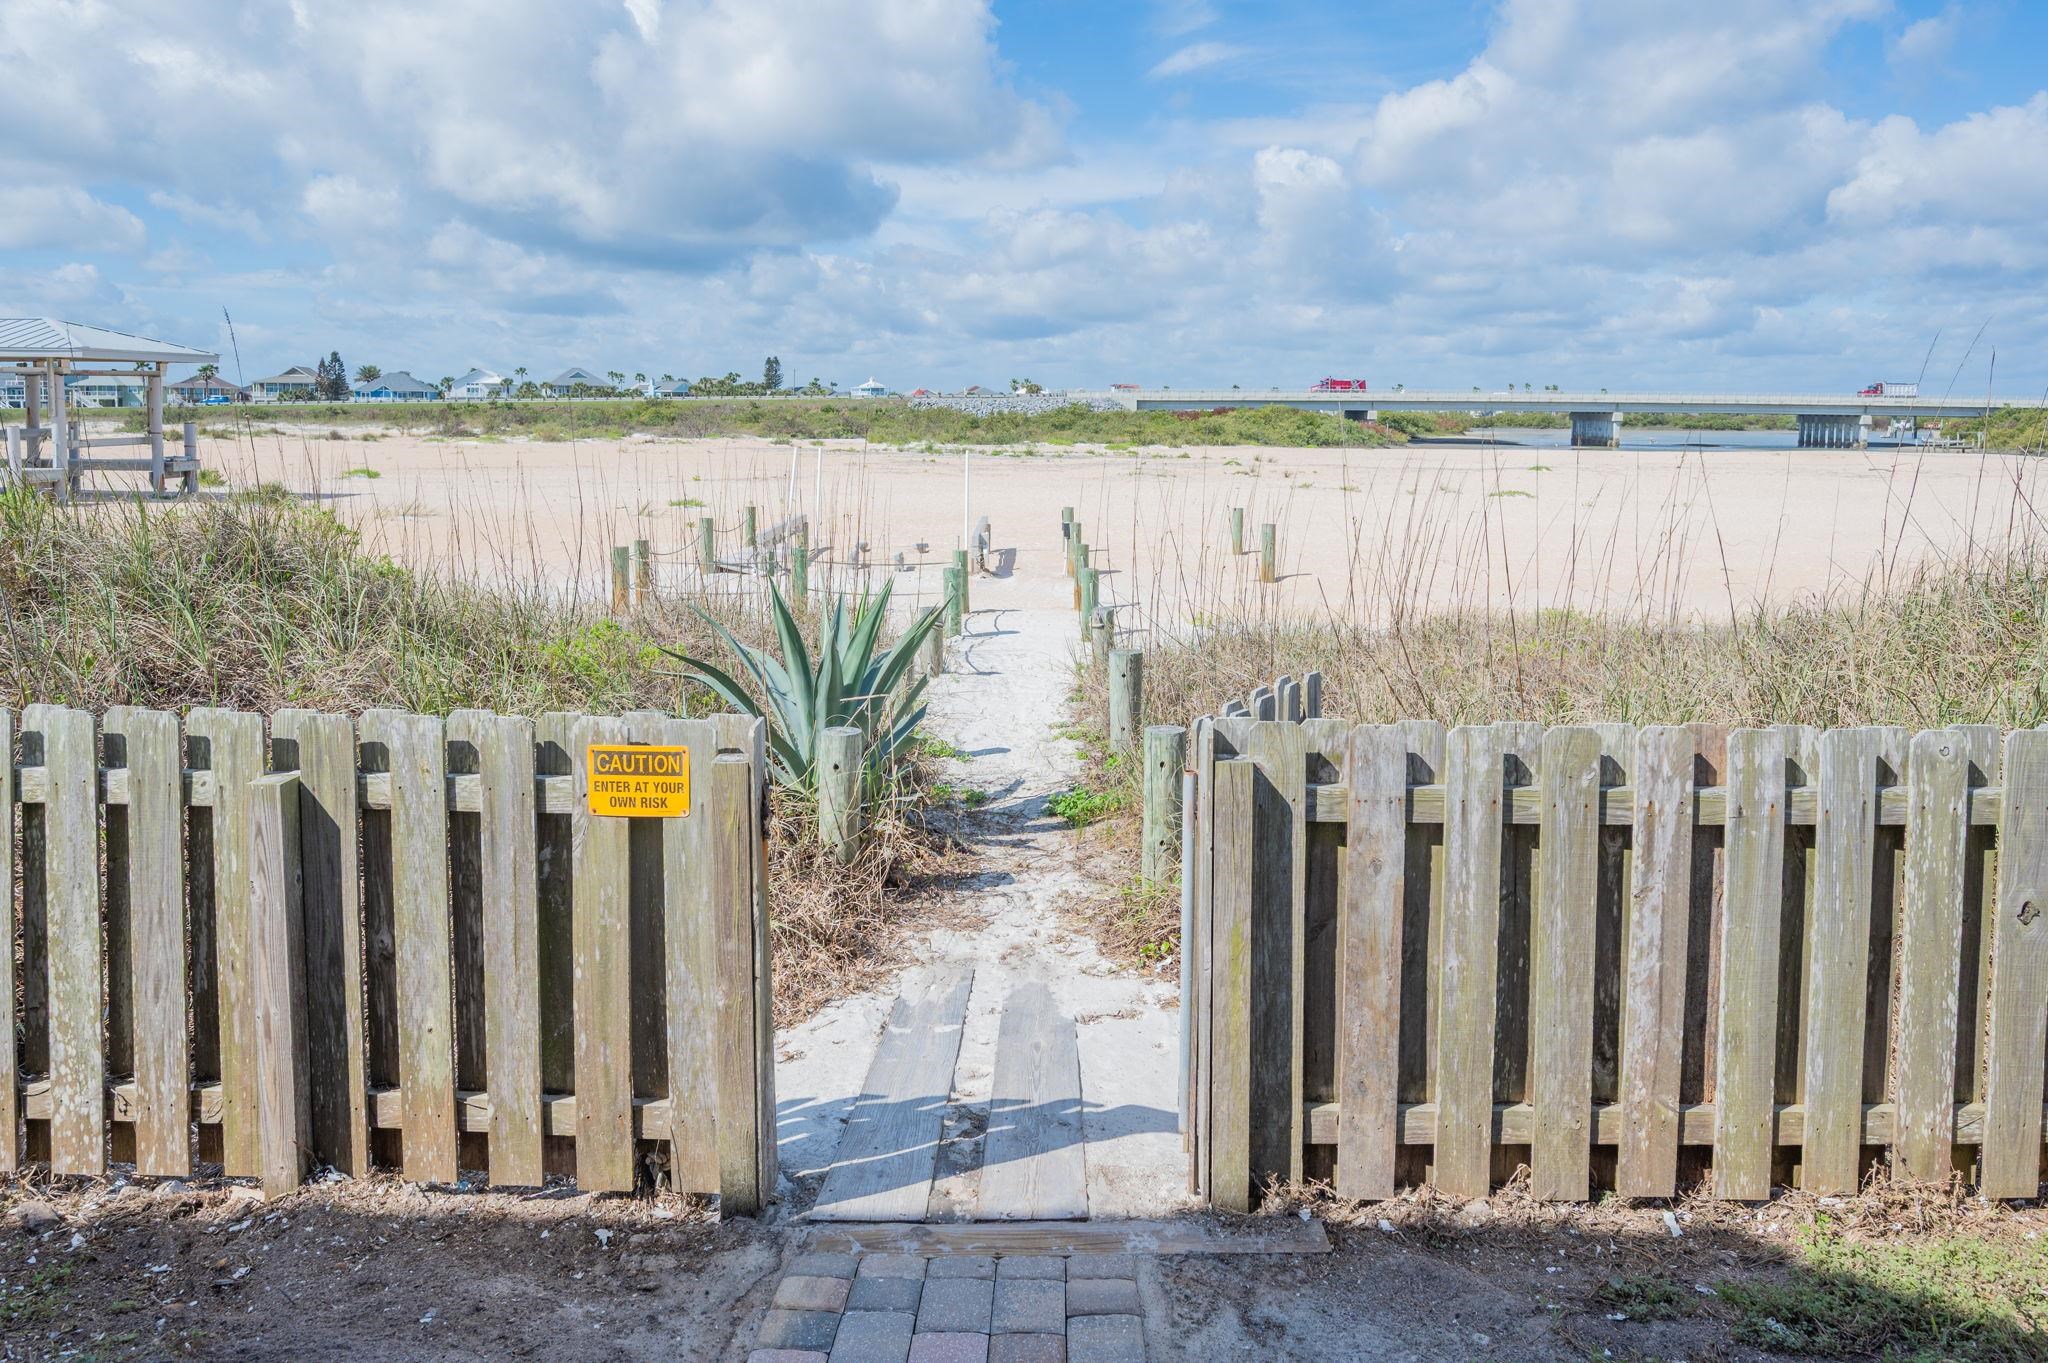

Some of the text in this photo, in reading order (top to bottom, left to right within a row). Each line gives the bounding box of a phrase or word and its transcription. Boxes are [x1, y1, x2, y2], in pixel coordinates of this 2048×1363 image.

[596, 753, 680, 773] CAUTION
[594, 781, 684, 794] ENTER AT YOUR
[610, 796, 668, 808] OWN RISK
